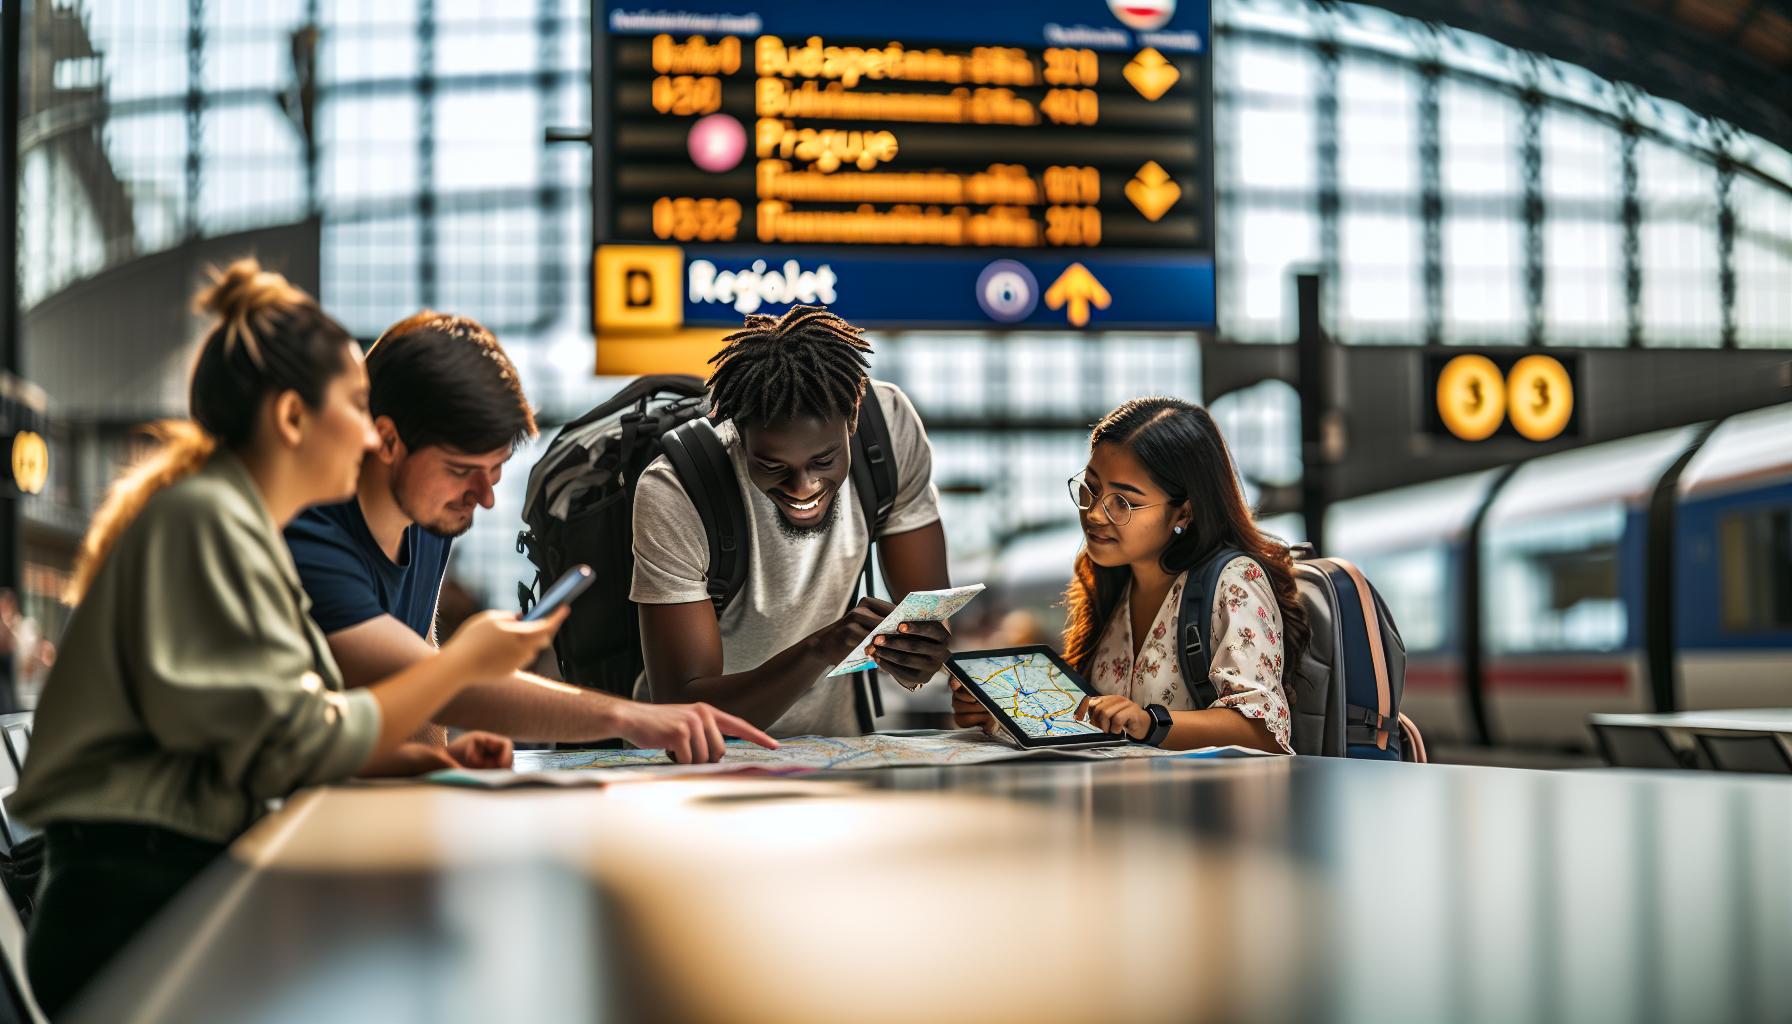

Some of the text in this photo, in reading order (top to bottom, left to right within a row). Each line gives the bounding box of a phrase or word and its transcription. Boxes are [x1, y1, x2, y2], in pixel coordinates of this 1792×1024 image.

[625, 269, 653, 308] D
[1464, 376, 1551, 417] 3 3
